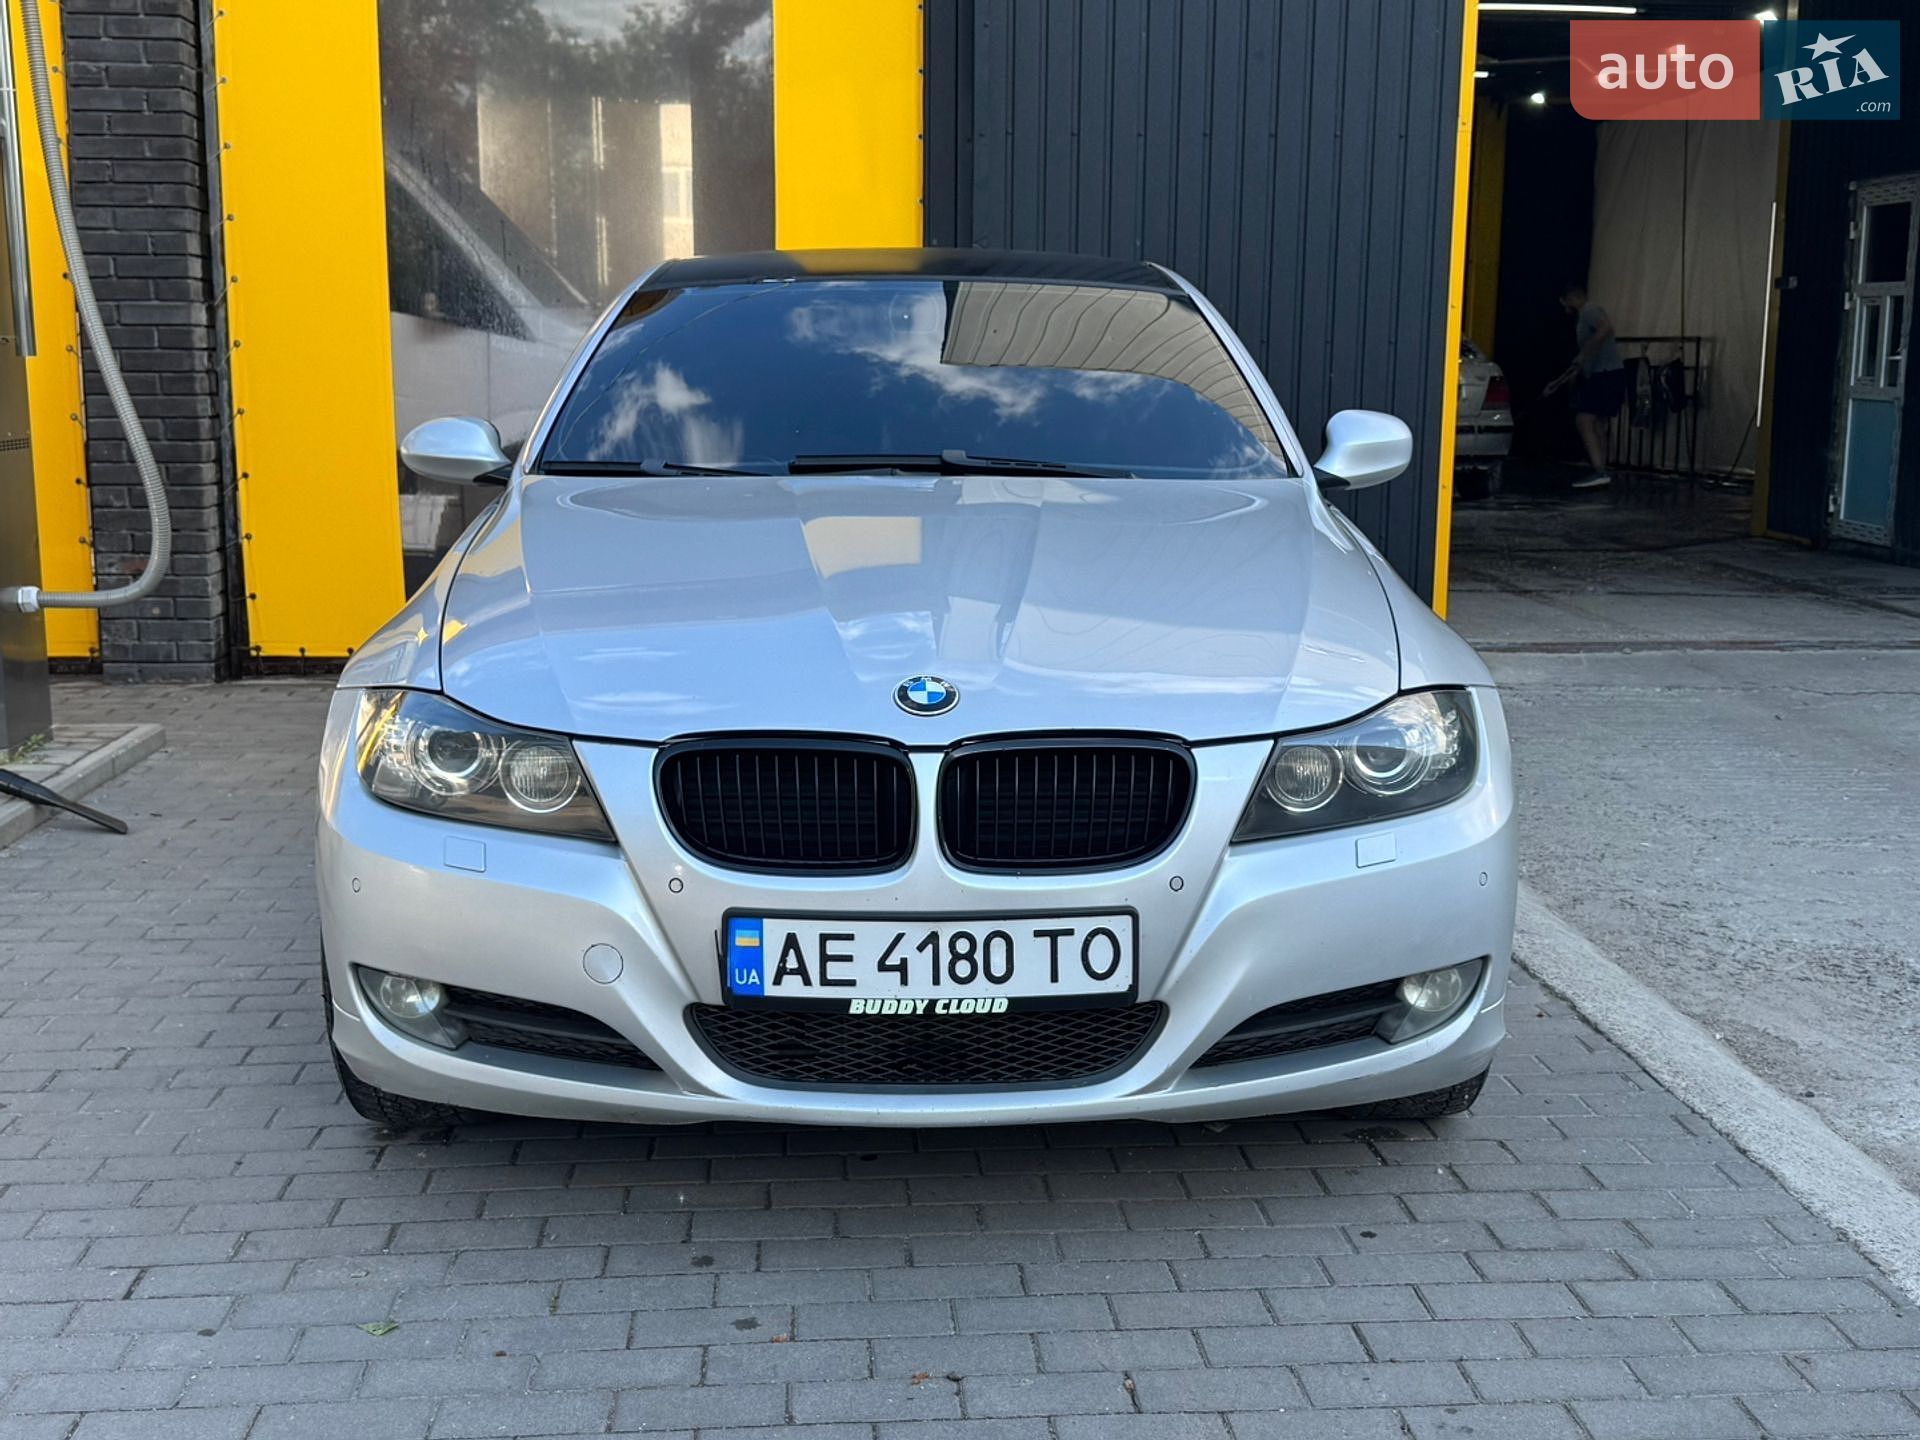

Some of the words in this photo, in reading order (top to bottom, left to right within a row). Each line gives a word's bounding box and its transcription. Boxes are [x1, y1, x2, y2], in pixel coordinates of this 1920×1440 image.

[735, 968, 760, 985] UA
[773, 932, 857, 986] AE
[877, 930, 1015, 985] 4180
[1033, 927, 1121, 983] TO
[849, 998, 929, 1015] BUDDY
[935, 997, 1009, 1014] CLOUD
